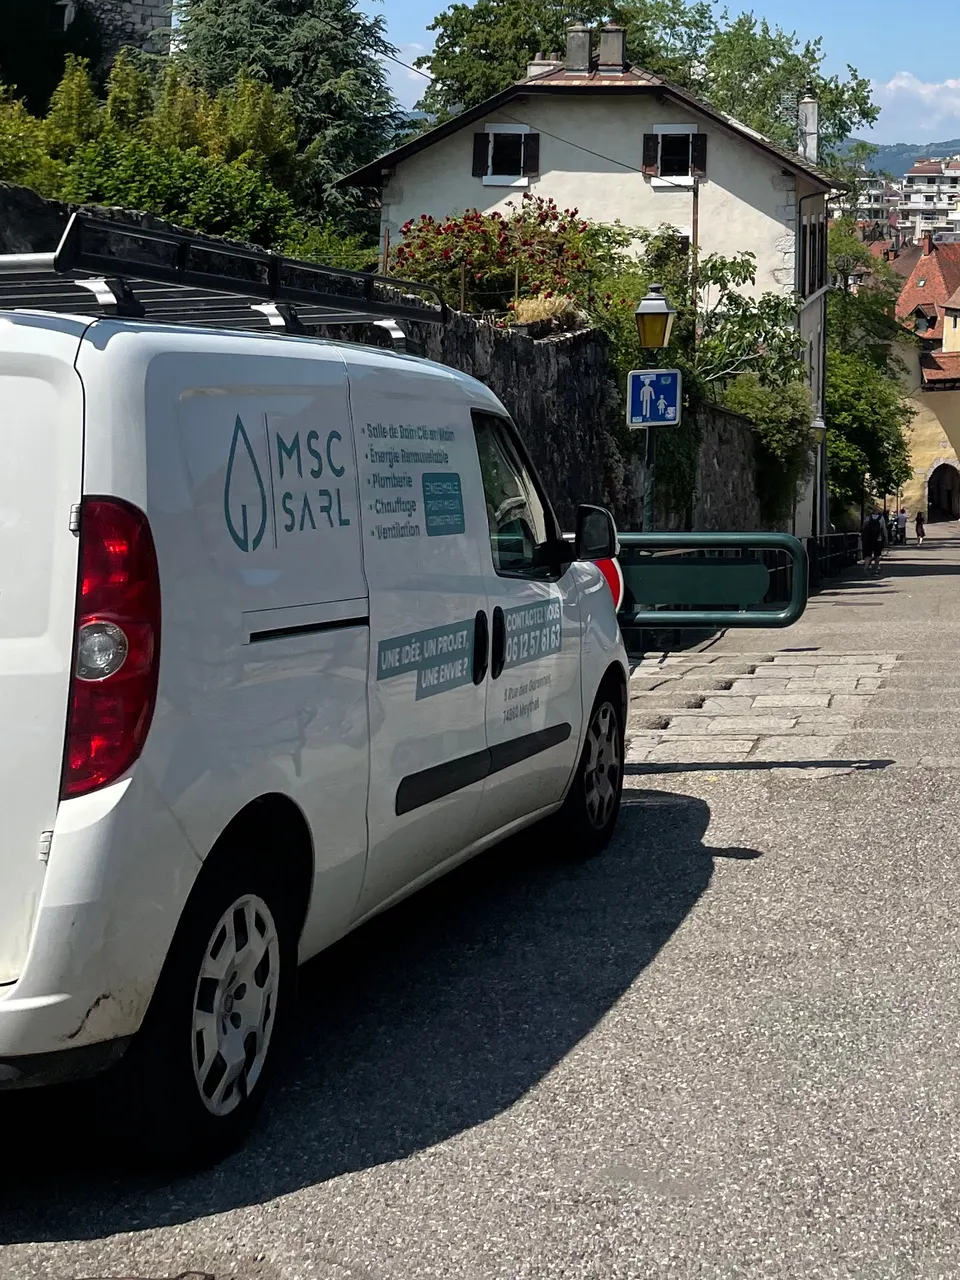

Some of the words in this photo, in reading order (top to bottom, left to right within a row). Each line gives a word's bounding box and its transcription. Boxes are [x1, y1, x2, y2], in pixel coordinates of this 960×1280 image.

[276, 430, 346, 480] MSC
[372, 472, 413, 488] Plomberie
[282, 488, 351, 533] SARL
[374, 497, 417, 517] Chauffage
[375, 521, 420, 540] Ventilation
[506, 607, 544, 632] CONTACTEZ
[381, 647, 400, 670] UNE
[401, 638, 422, 663] IDÉE,
[424, 638, 436, 658] UN
[437, 630, 469, 655] PROJET,
[506, 636, 518, 663] 06
[519, 632, 528, 659] 12
[529, 630, 540, 655] 57
[541, 627, 550, 652] 61
[550, 623, 560, 649] 63
[421, 667, 439, 688] UNE
[439, 659, 462, 683] ENVIE
